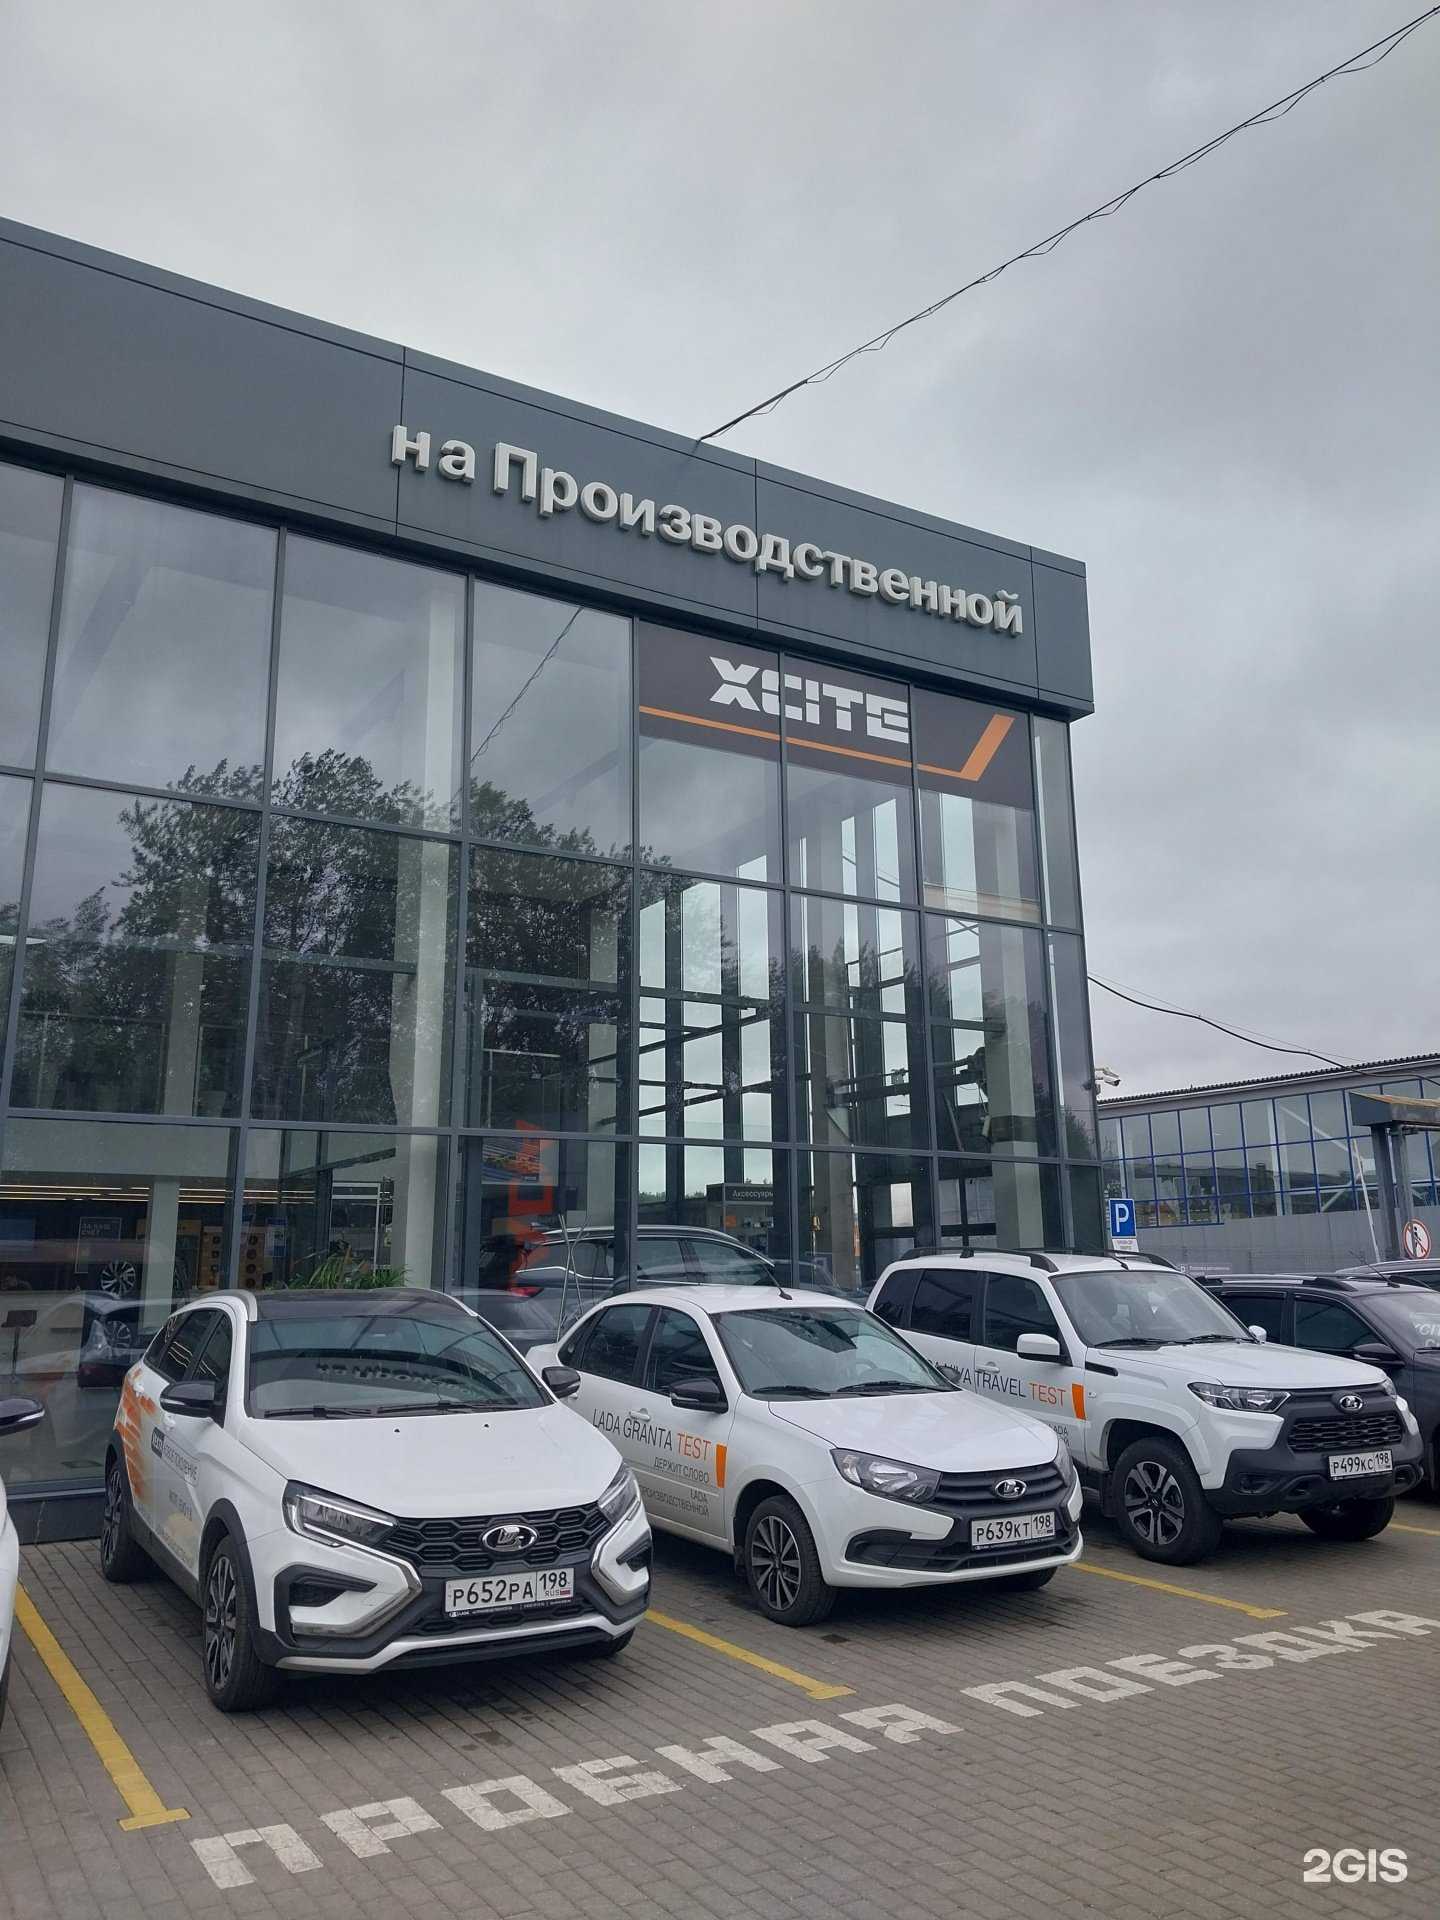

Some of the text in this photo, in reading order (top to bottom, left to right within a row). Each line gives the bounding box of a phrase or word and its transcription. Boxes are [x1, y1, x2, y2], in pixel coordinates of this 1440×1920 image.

[390, 424, 1024, 638] на Производственной
[708, 656, 910, 745] XCITE
[975, 1370, 1027, 1398] TRAVEL
[1029, 1382, 1067, 1407] TEST
[592, 1408, 712, 1461] LADA GRANTA TEST
[653, 1457, 710, 1484] ДЕРЖИТ СЛОВО
[1375, 1453, 1389, 1465] 198
[1033, 1515, 1051, 1530] 198
[539, 1571, 569, 1591] 198
[189, 1609, 1440, 1890] ПРОБНАЯ ПОЕЗДКА
